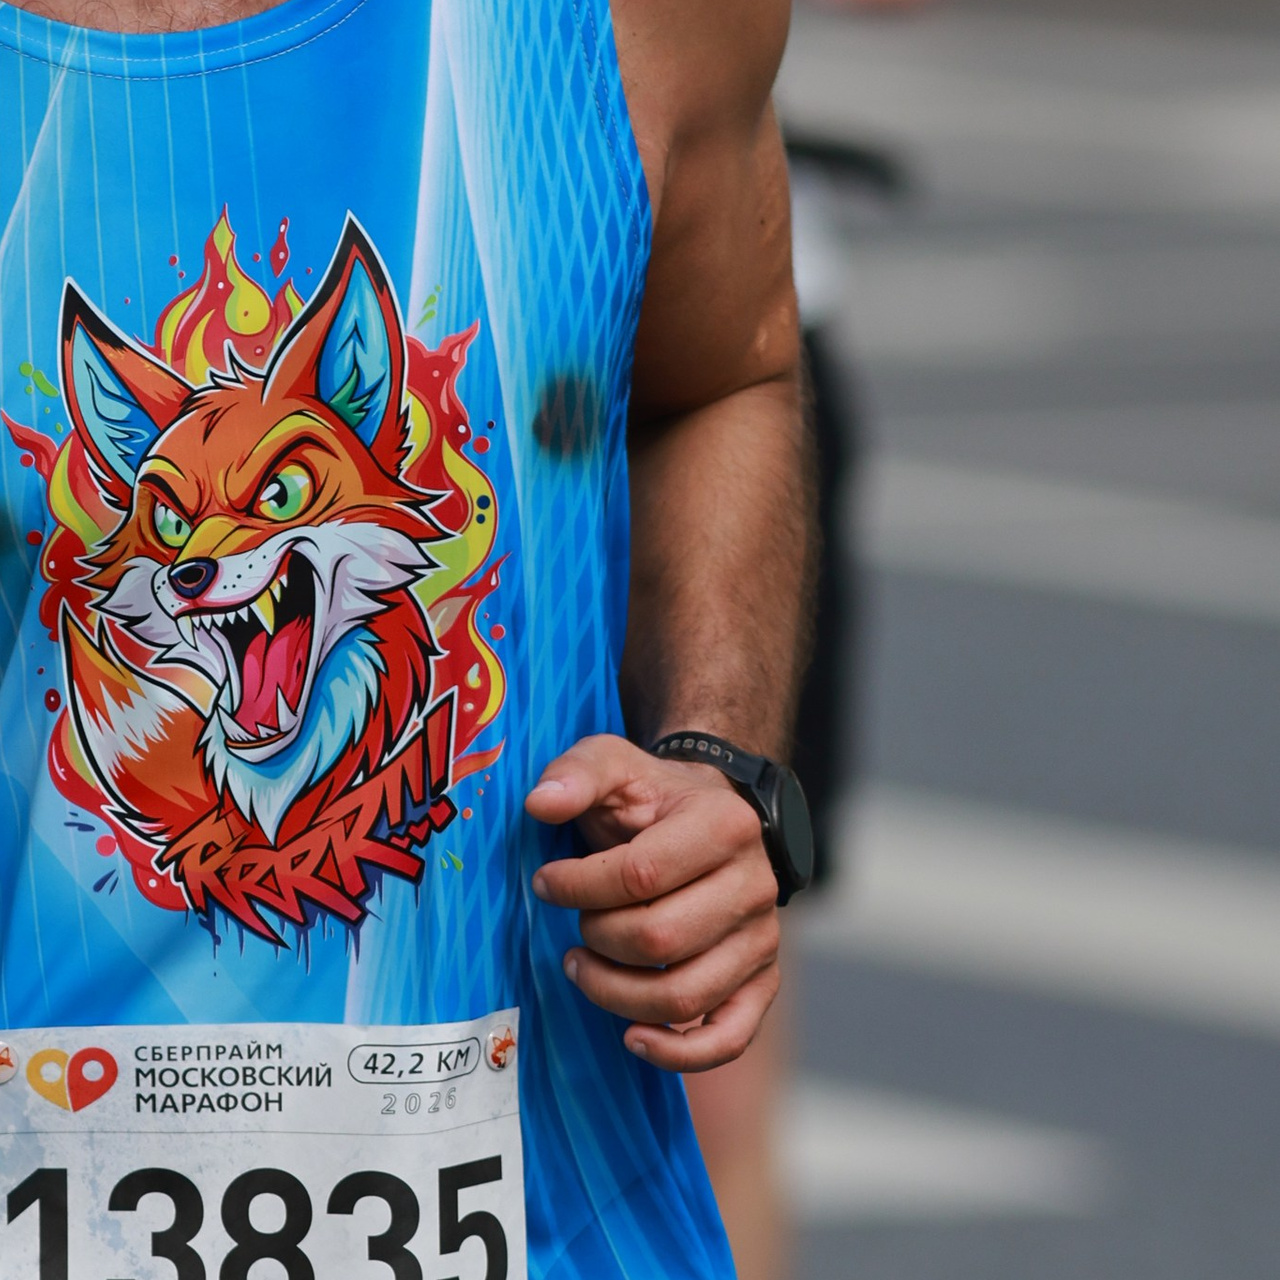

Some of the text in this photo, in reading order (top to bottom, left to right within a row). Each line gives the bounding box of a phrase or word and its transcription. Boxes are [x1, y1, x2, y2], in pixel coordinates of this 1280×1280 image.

[134, 1040, 283, 1062] СБЕРПРАЙМ
[363, 1046, 470, 1078] 42,2 КМ
[135, 1062, 332, 1088] МОСКОВСКИЙ
[135, 1091, 283, 1114] МАРАФОН
[380, 1086, 457, 1115] 2026
